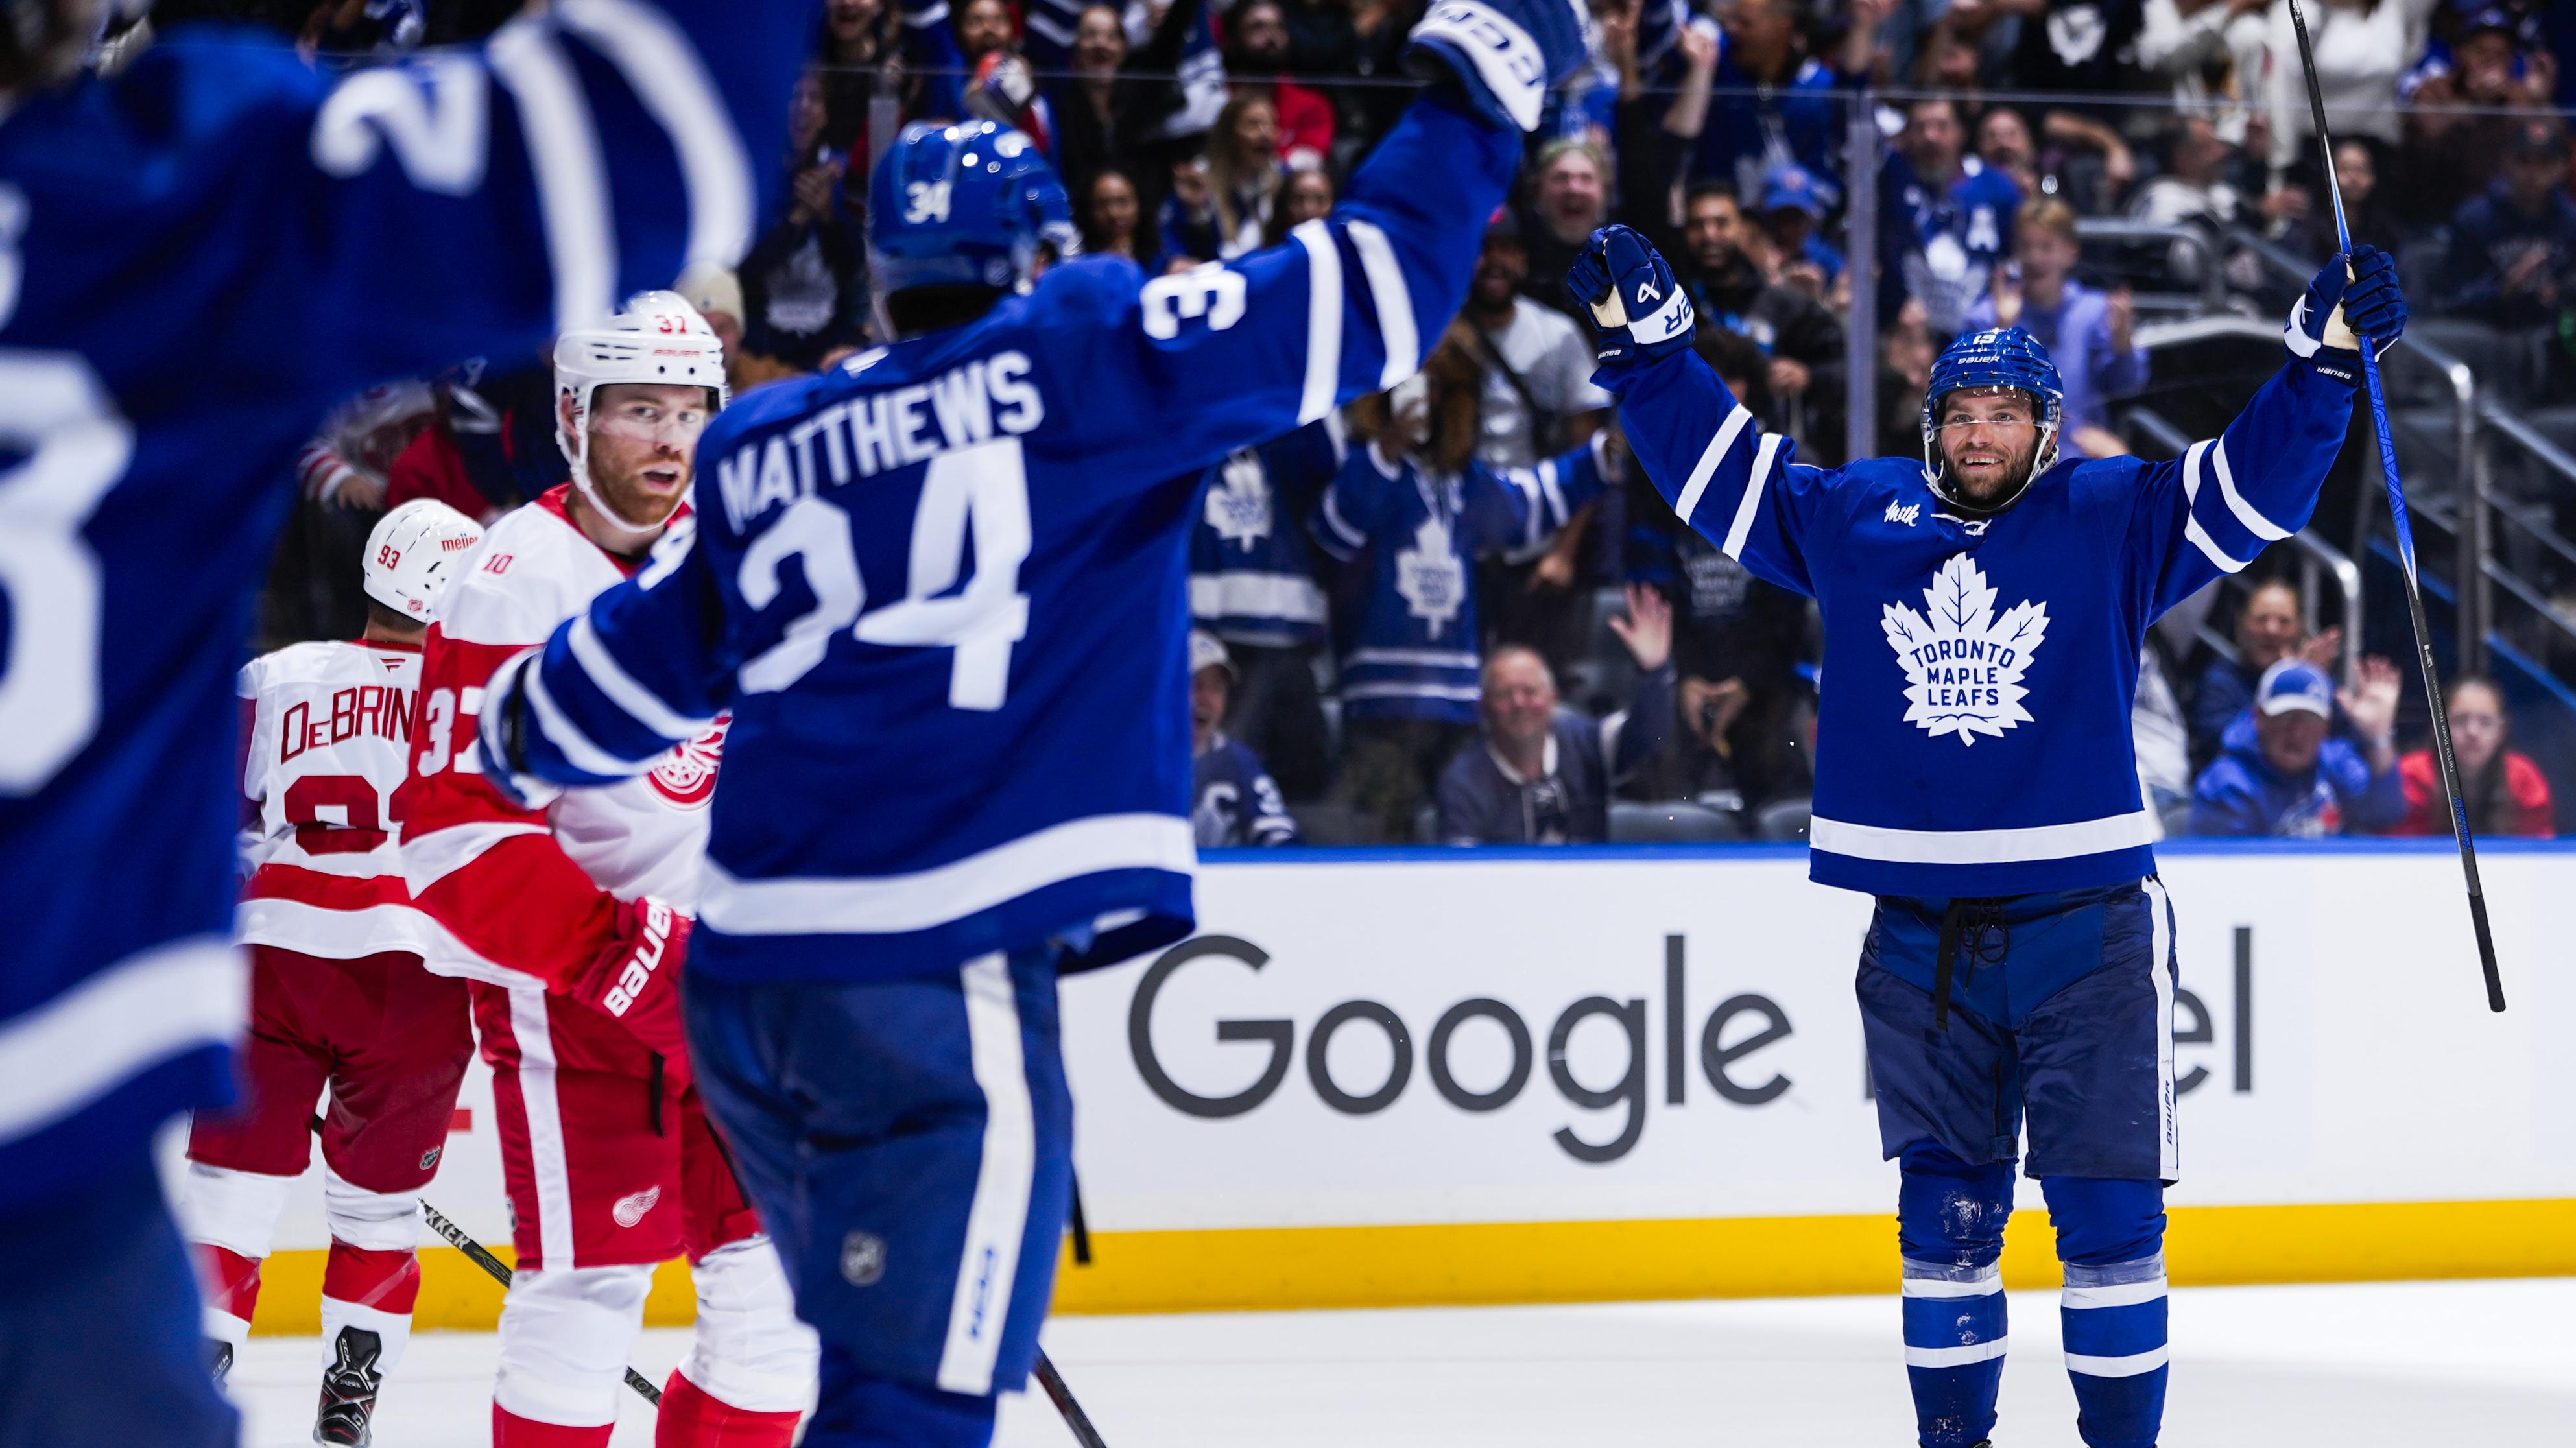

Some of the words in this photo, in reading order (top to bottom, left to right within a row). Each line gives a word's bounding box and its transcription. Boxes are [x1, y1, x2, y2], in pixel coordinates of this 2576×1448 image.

[904, 180, 951, 224] 34
[655, 315, 686, 333] 37
[1958, 355, 2000, 364] BAUER
[2317, 366, 2352, 379] BAUER
[378, 545, 400, 571] 93
[483, 554, 513, 574] 10
[737, 436, 1032, 712] 34
[1910, 638, 2016, 669] TORONTO
[1927, 667, 1998, 685] MAPLE
[1927, 689, 1999, 706] LEAFS
[1128, 934, 1794, 1163] Google
[341, 1337, 351, 1363] CCM
